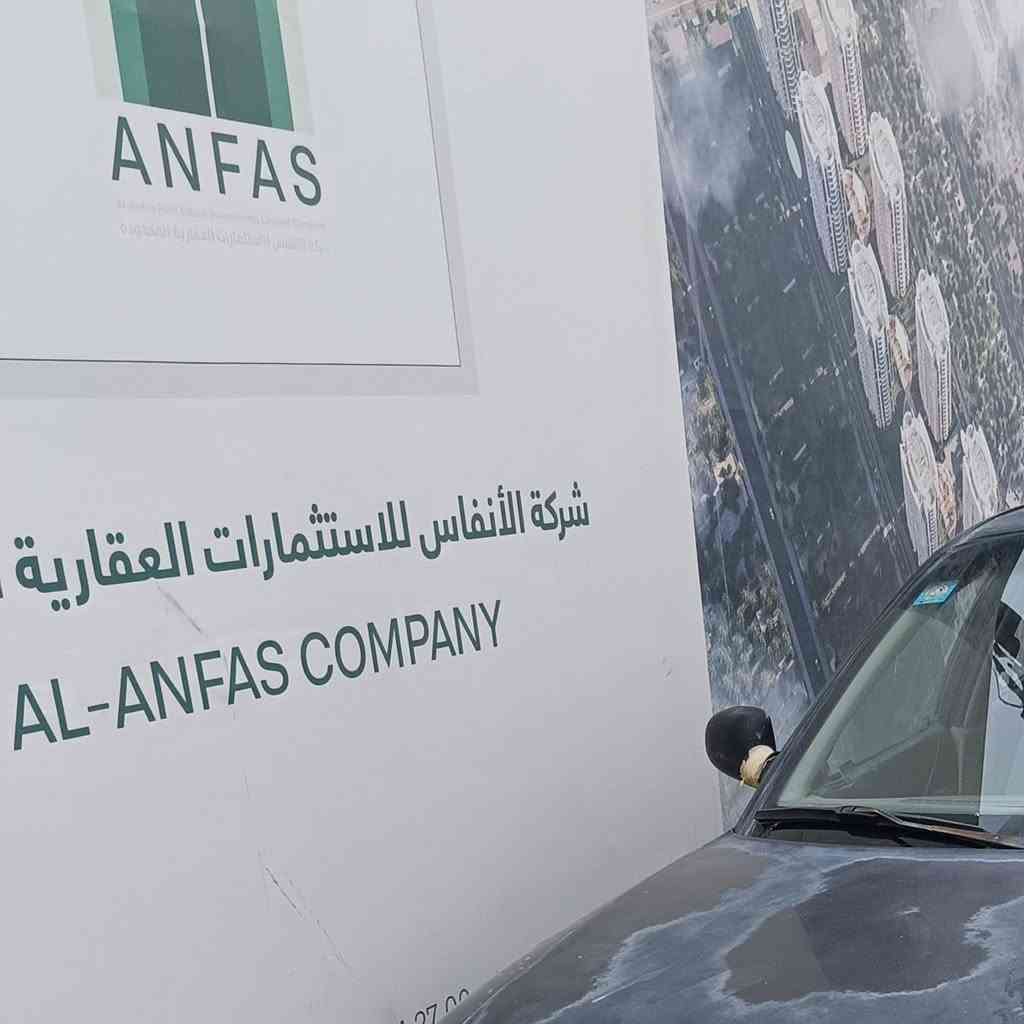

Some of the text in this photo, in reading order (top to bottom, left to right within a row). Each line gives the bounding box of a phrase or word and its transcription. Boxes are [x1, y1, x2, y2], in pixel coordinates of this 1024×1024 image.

[112, 116, 322, 206] ANFAS
[15, 481, 590, 612] شركة الأنفاس للاستثمارات العقارية
[13, 600, 501, 751] AL-ANFAS COMPANY
